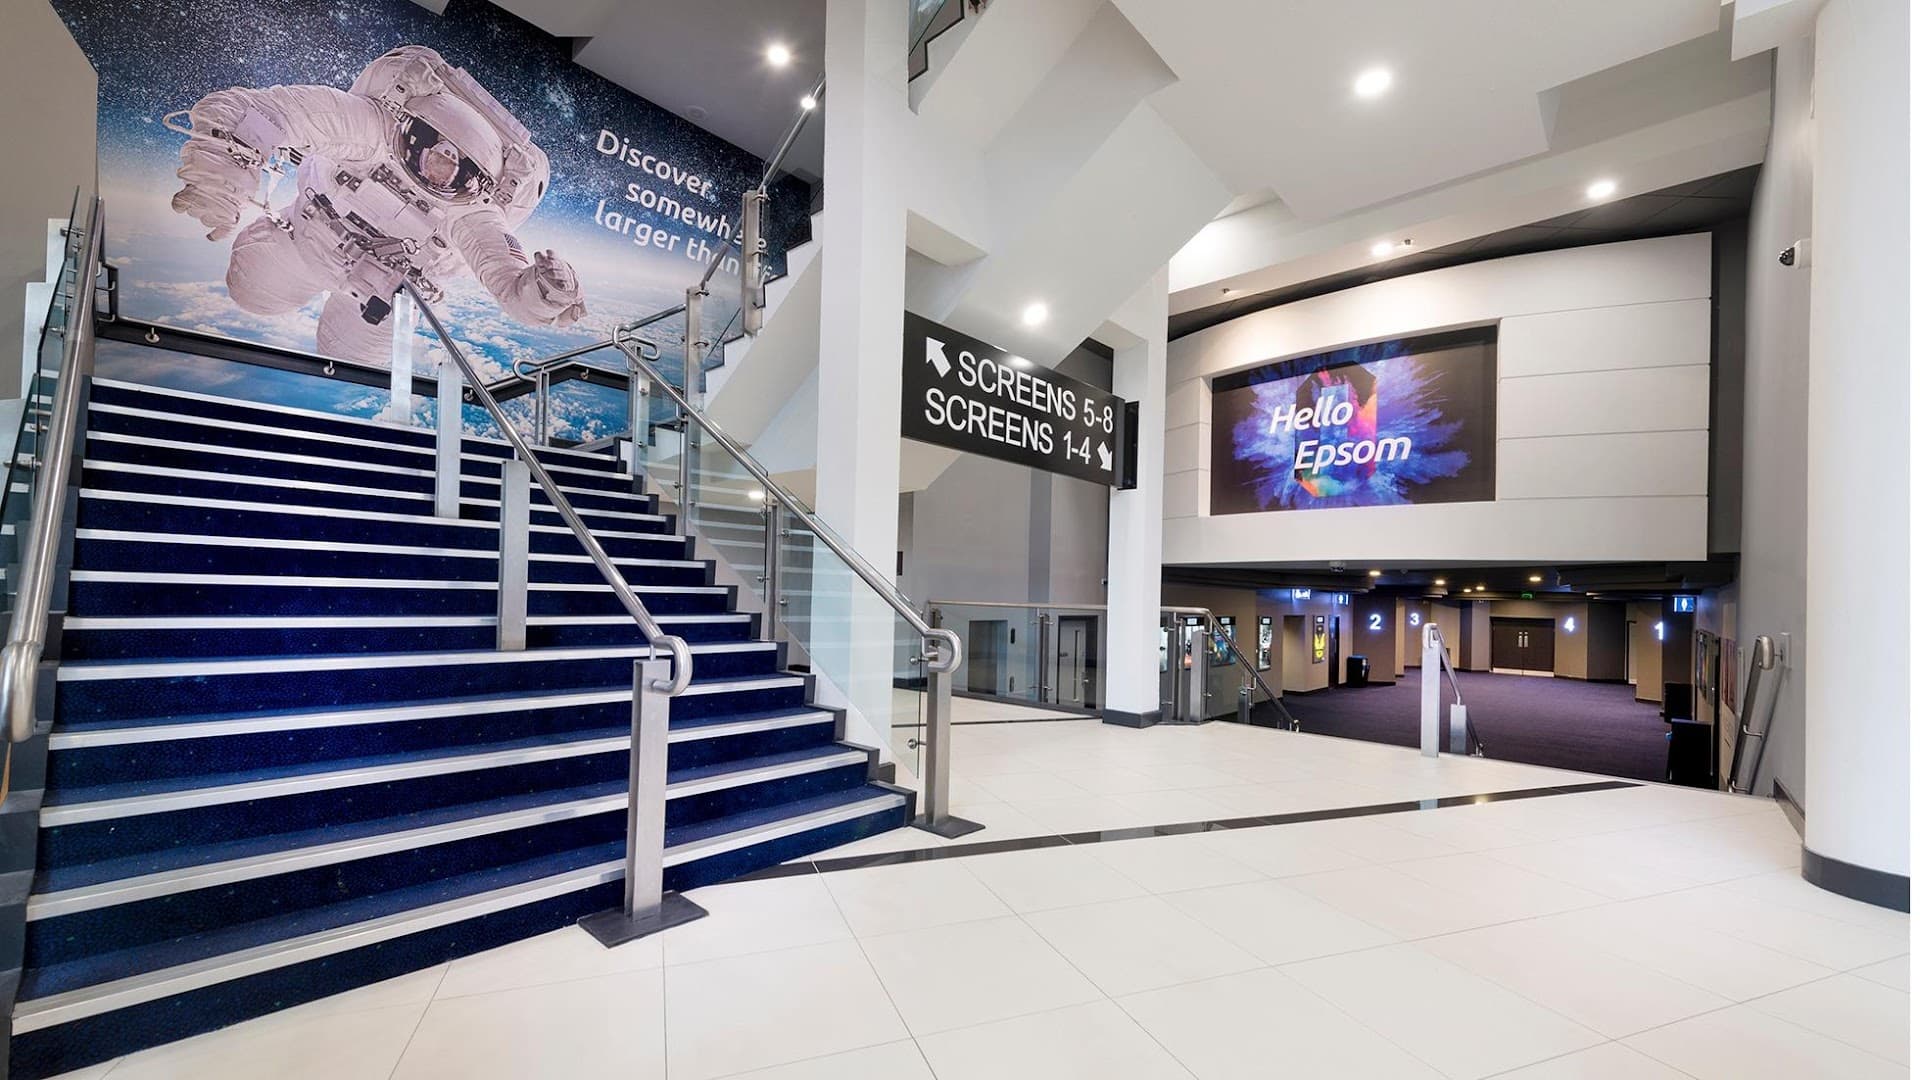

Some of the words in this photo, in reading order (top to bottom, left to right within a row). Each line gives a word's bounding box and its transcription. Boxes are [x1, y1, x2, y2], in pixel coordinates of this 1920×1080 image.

[596, 128, 712, 199] Discover
[594, 201, 680, 252] larger
[957, 350, 1076, 421] SCREENS
[1083, 398, 1114, 434] 5-8
[925, 387, 1054, 455] SCREENS
[1063, 430, 1091, 465] 1-4
[1269, 395, 1354, 434] Hello
[1294, 436, 1412, 475] Epsom
[1369, 613, 1382, 630] 2
[1409, 613, 1420, 626] 3
[1564, 617, 1575, 632] 4
[1655, 621, 1664, 640] 1
